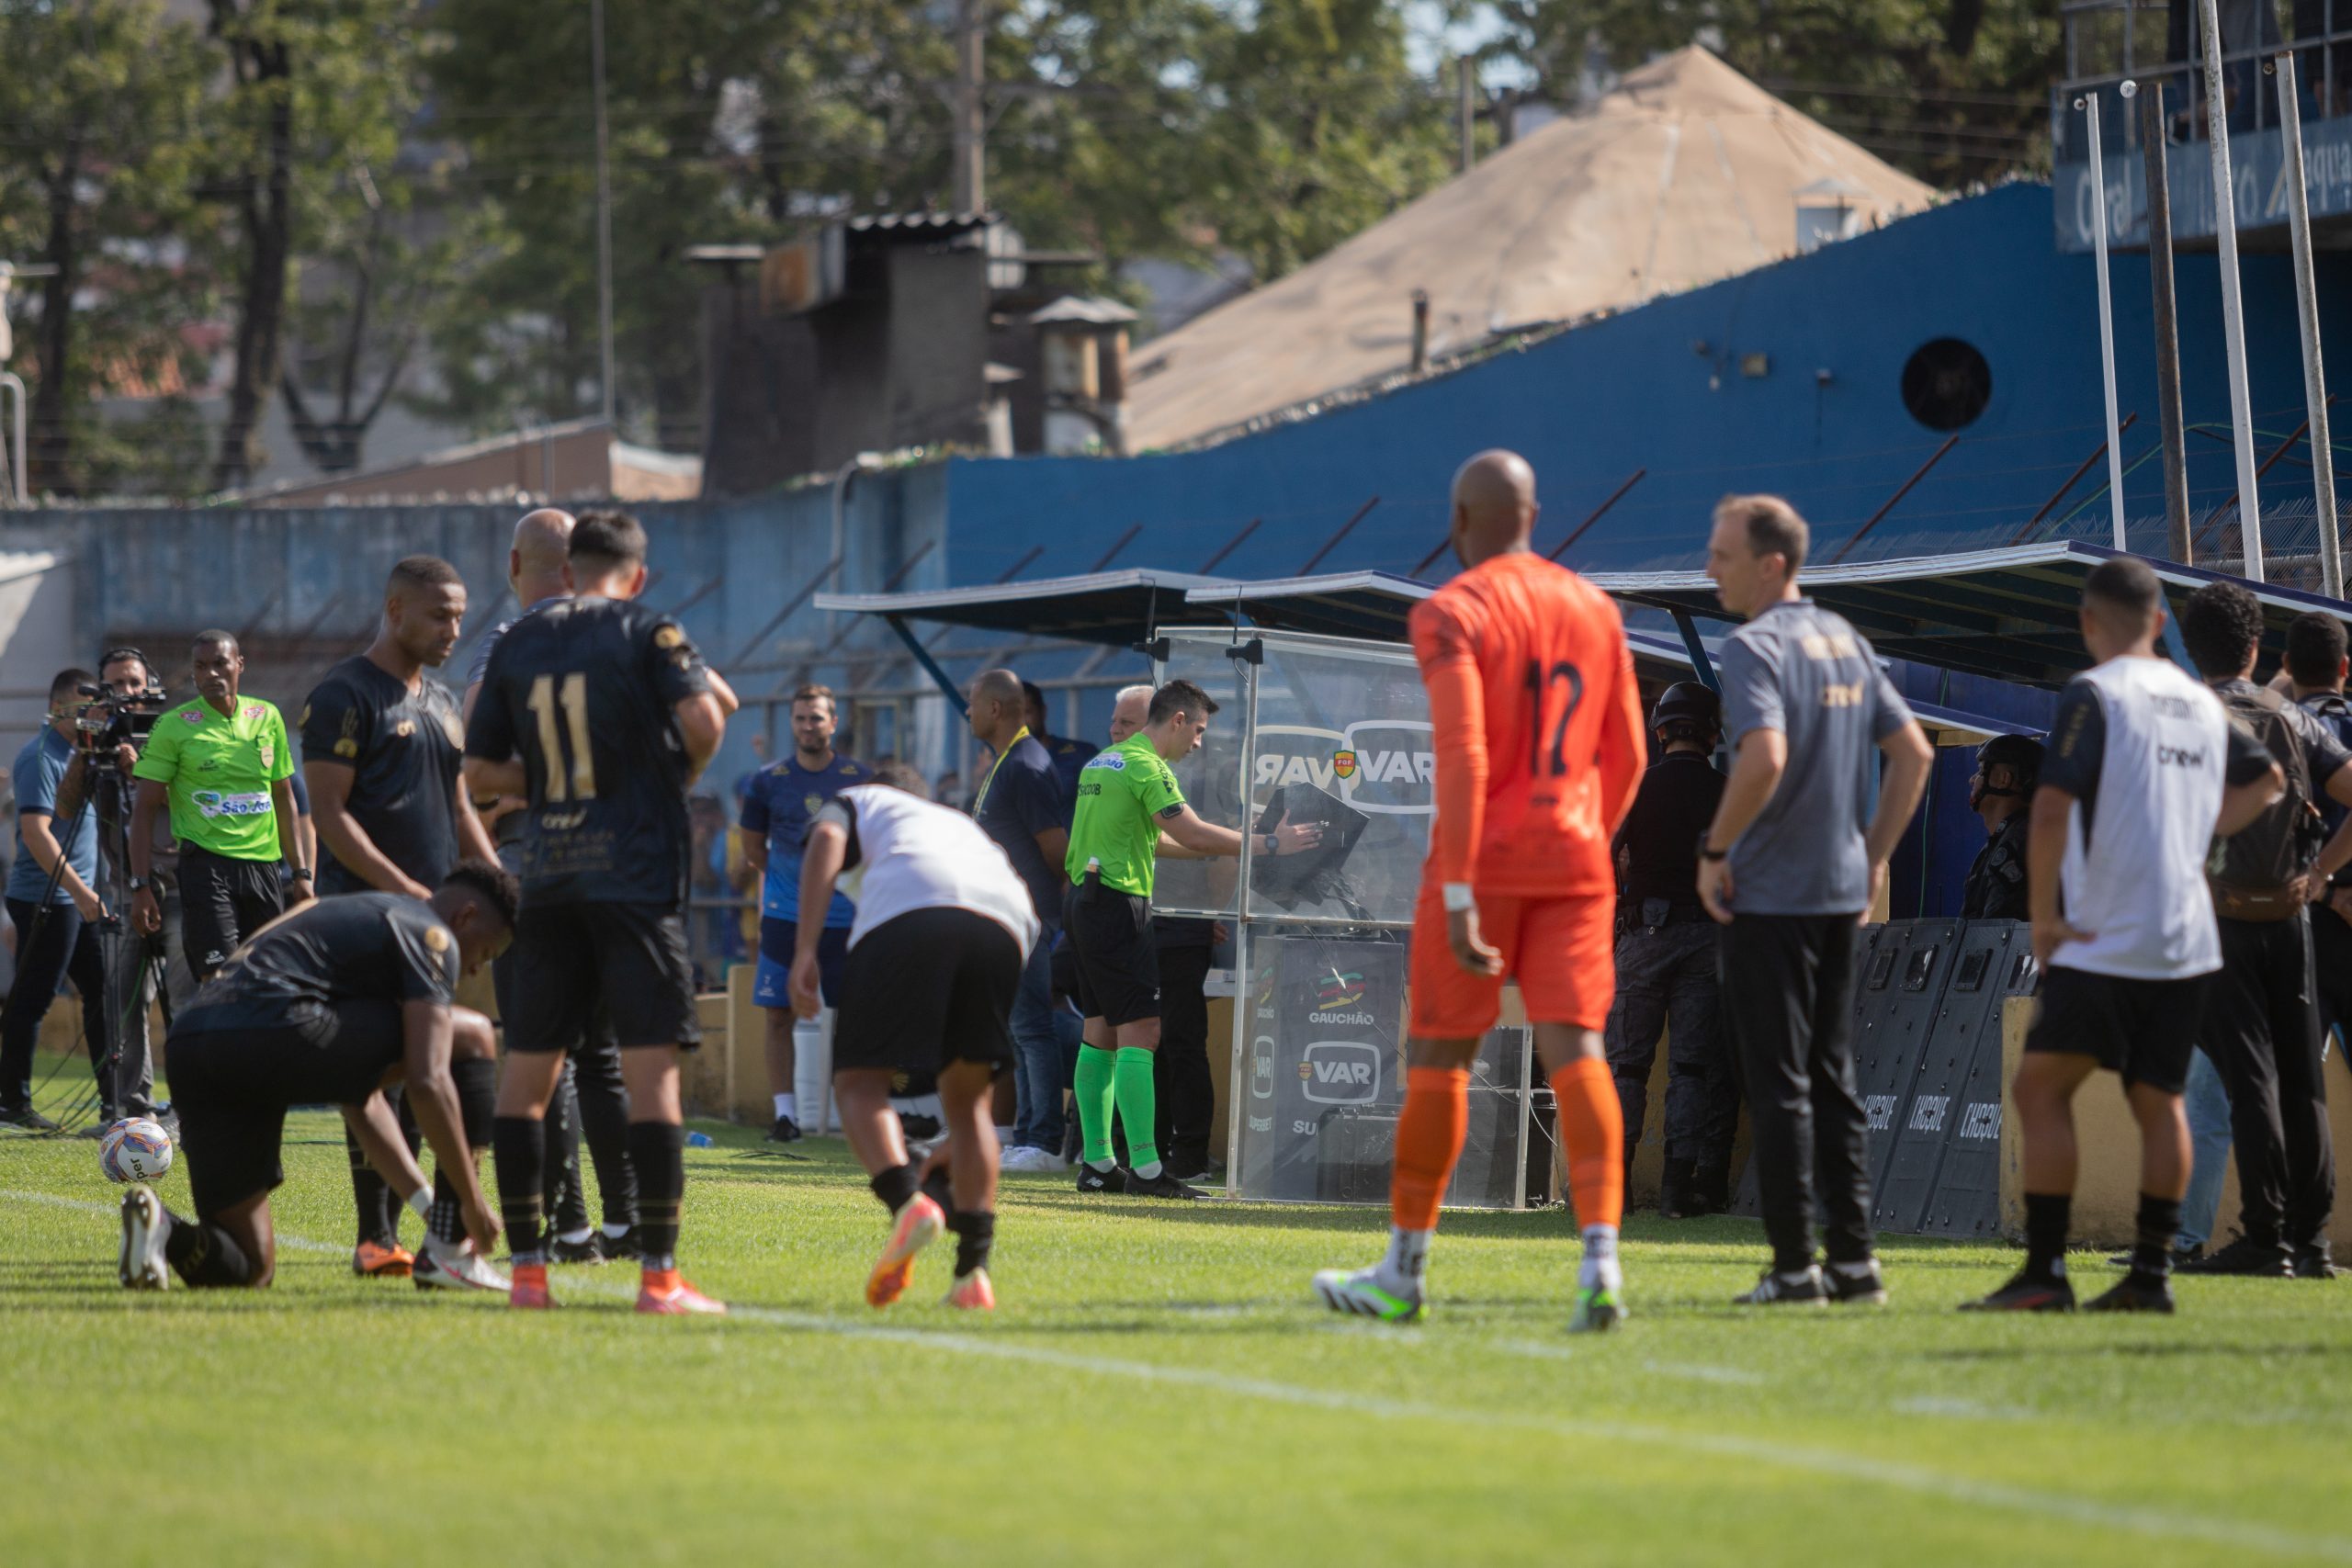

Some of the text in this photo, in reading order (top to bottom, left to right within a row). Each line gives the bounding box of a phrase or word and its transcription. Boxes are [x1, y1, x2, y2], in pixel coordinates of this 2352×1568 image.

[1524, 659, 1583, 777] 12
[527, 671, 597, 803] 11
[1356, 750, 1436, 784] VAR
[221, 801, 247, 814] São
[1309, 1010, 1374, 1025] GAUCHÃO
[1256, 1056, 1272, 1078] VAR
[1314, 1061, 1371, 1085] VAR
[1908, 1095, 1951, 1134] CHOQUE
[130, 1158, 148, 1182] per
